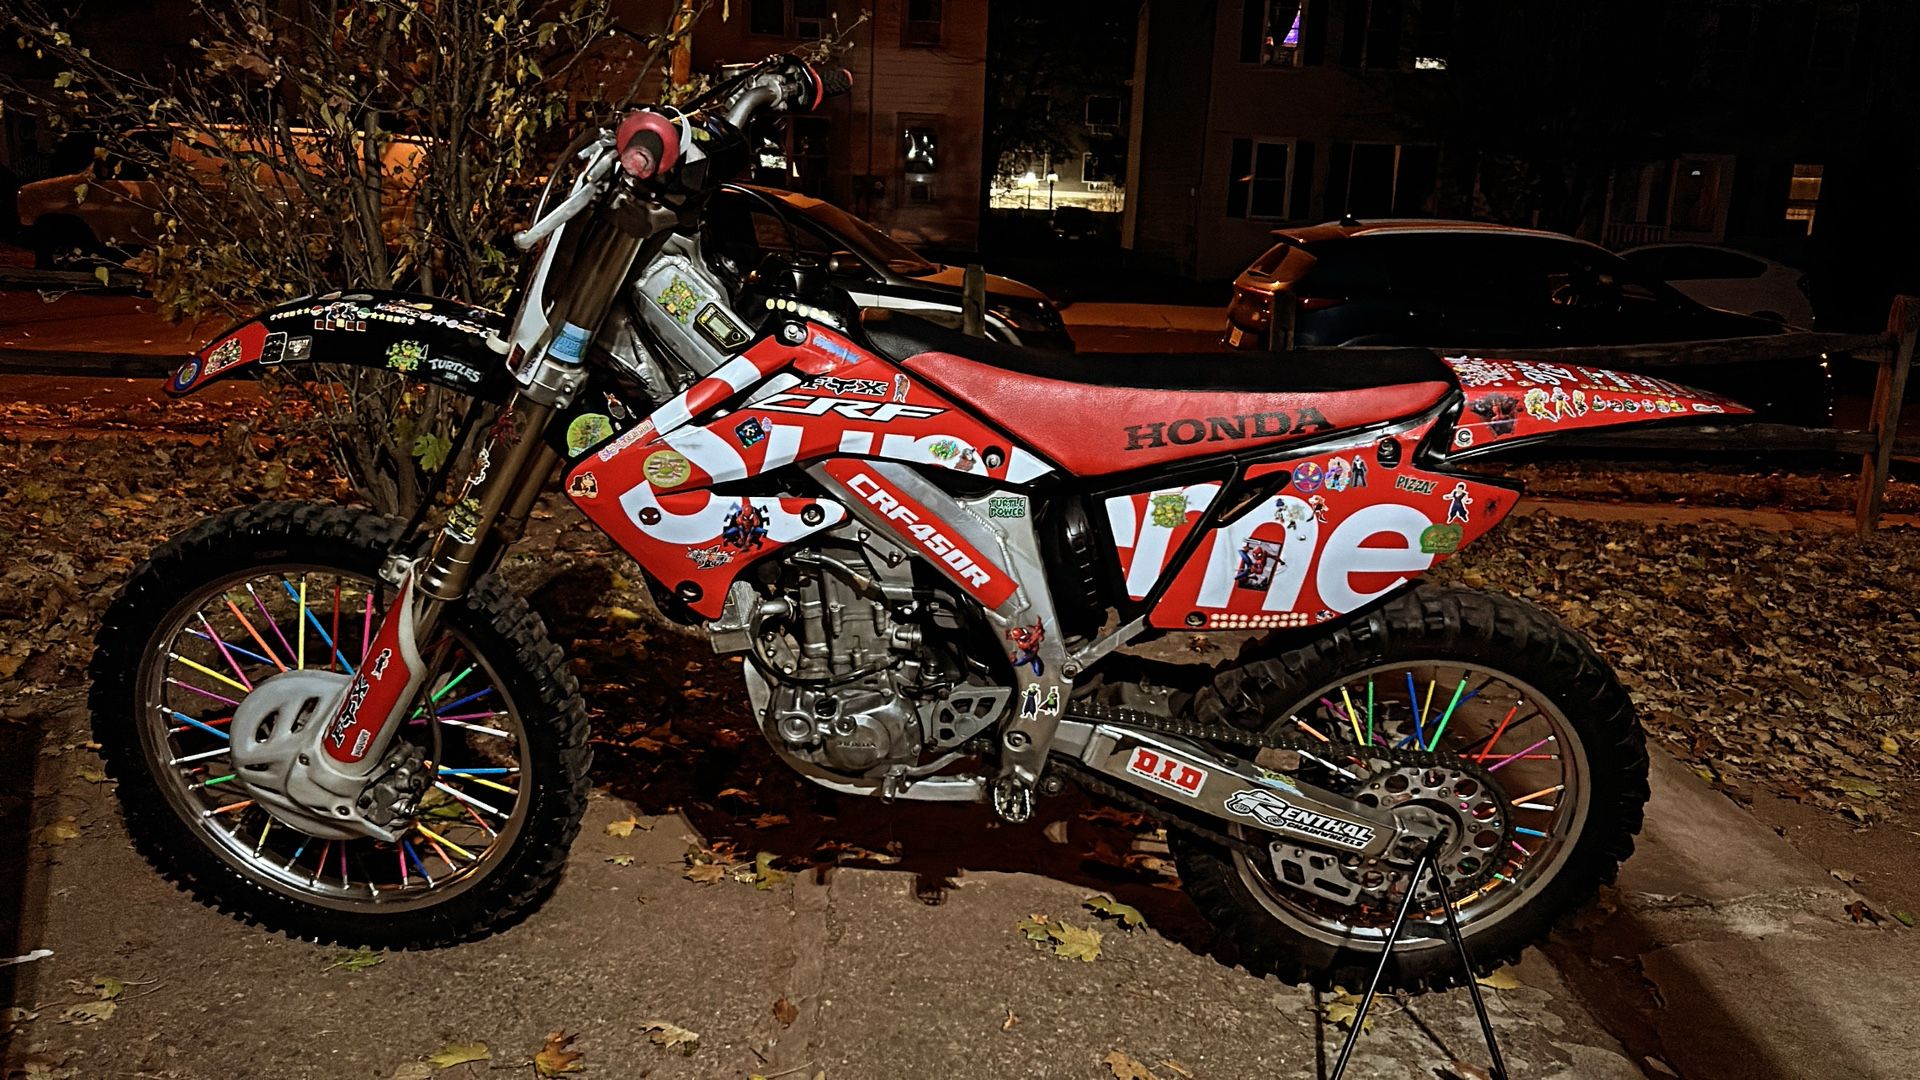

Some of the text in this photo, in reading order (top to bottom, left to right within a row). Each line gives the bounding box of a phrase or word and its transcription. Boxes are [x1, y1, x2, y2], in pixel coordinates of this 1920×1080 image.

[428, 358, 480, 383] TURTLES
[747, 393, 945, 422] CRF
[1124, 408, 1335, 450] HONDA
[1395, 475, 1438, 495] PIZZA!
[989, 507, 1025, 518] POWER
[990, 497, 1026, 508] TURTLE
[846, 473, 992, 589] CRF450R
[1133, 748, 1203, 791] D.I.D
[1226, 789, 1373, 842] RENTHAL
[1286, 822, 1365, 847] CHAINWHEELS
